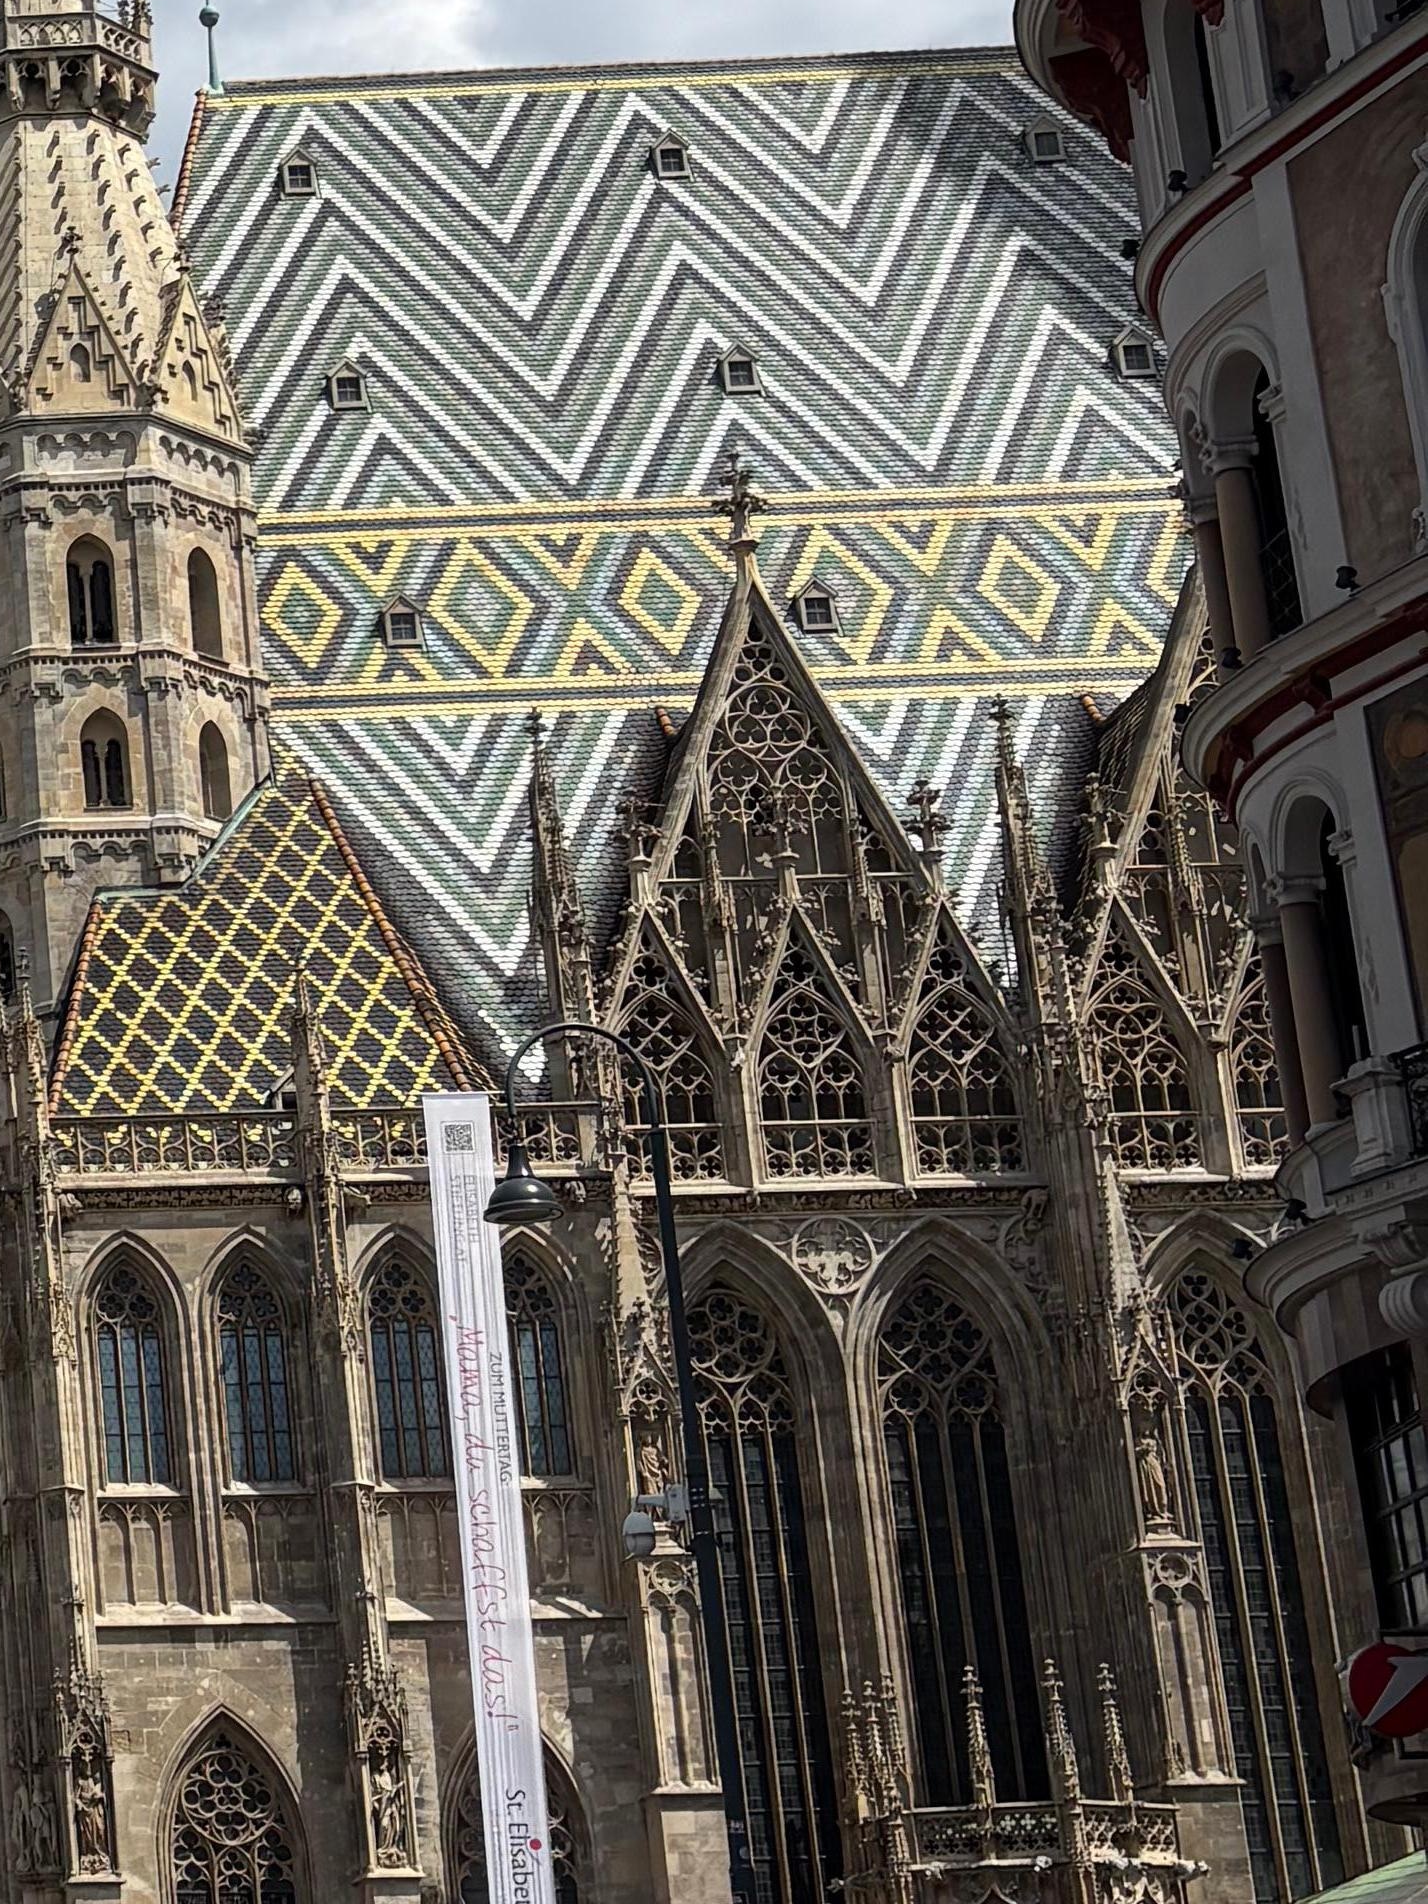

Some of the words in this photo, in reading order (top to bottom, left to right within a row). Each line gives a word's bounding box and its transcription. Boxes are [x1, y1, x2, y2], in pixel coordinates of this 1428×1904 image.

[489, 1351, 504, 1388] ZUM
[464, 1432, 495, 1474] du
[468, 1489, 508, 1632] schaffst
[505, 1788, 526, 1816] St.
